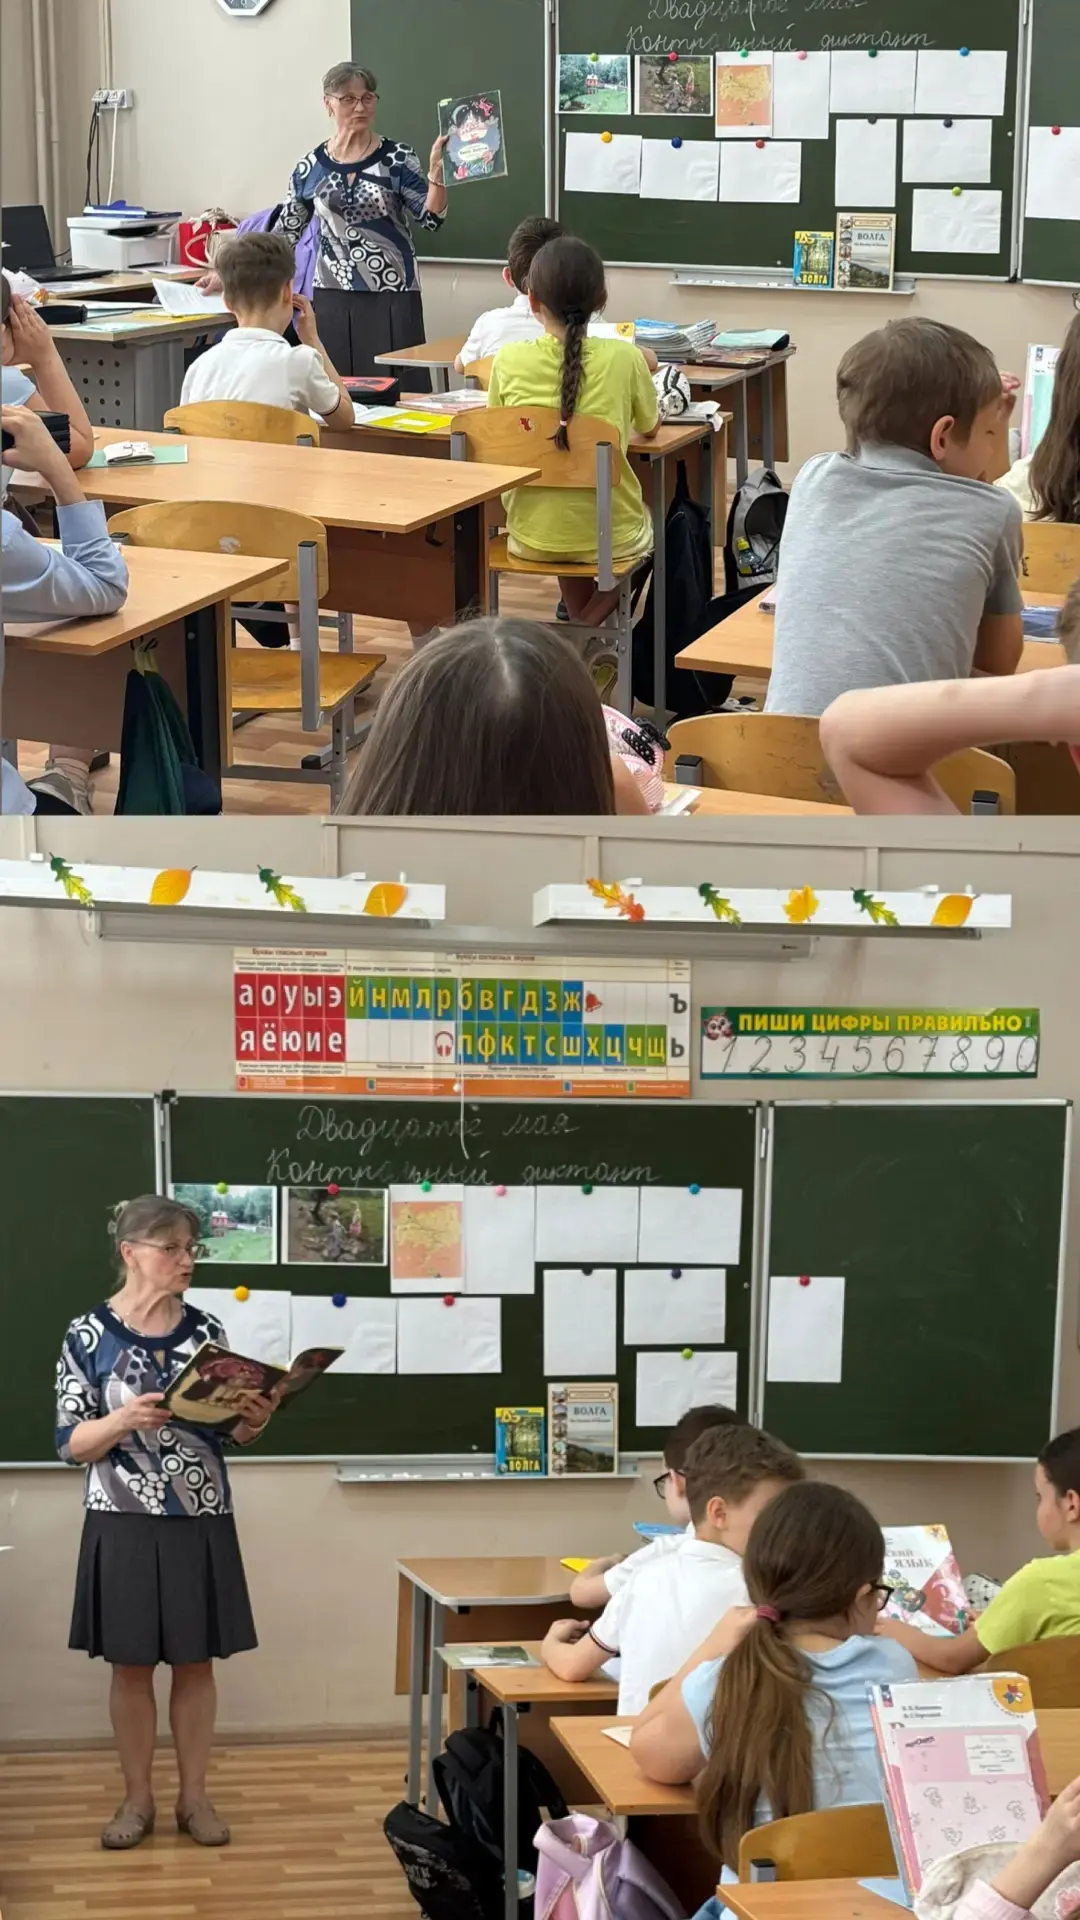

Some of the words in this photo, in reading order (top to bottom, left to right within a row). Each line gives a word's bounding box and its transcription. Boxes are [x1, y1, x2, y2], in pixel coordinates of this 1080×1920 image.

[820, 30, 935, 51] диктант
[857, 232, 886, 241] ВОЛГА
[802, 274, 828, 285] ВОЛГА
[738, 1014, 805, 1031] ПИШИ
[811, 1014, 890, 1033] ЦИФРЫ
[502, 1112, 581, 1137] мая
[521, 1161, 661, 1185] диктант
[574, 1406, 608, 1416] ВОЛГА
[508, 1460, 540, 1471] ВОЛГА
